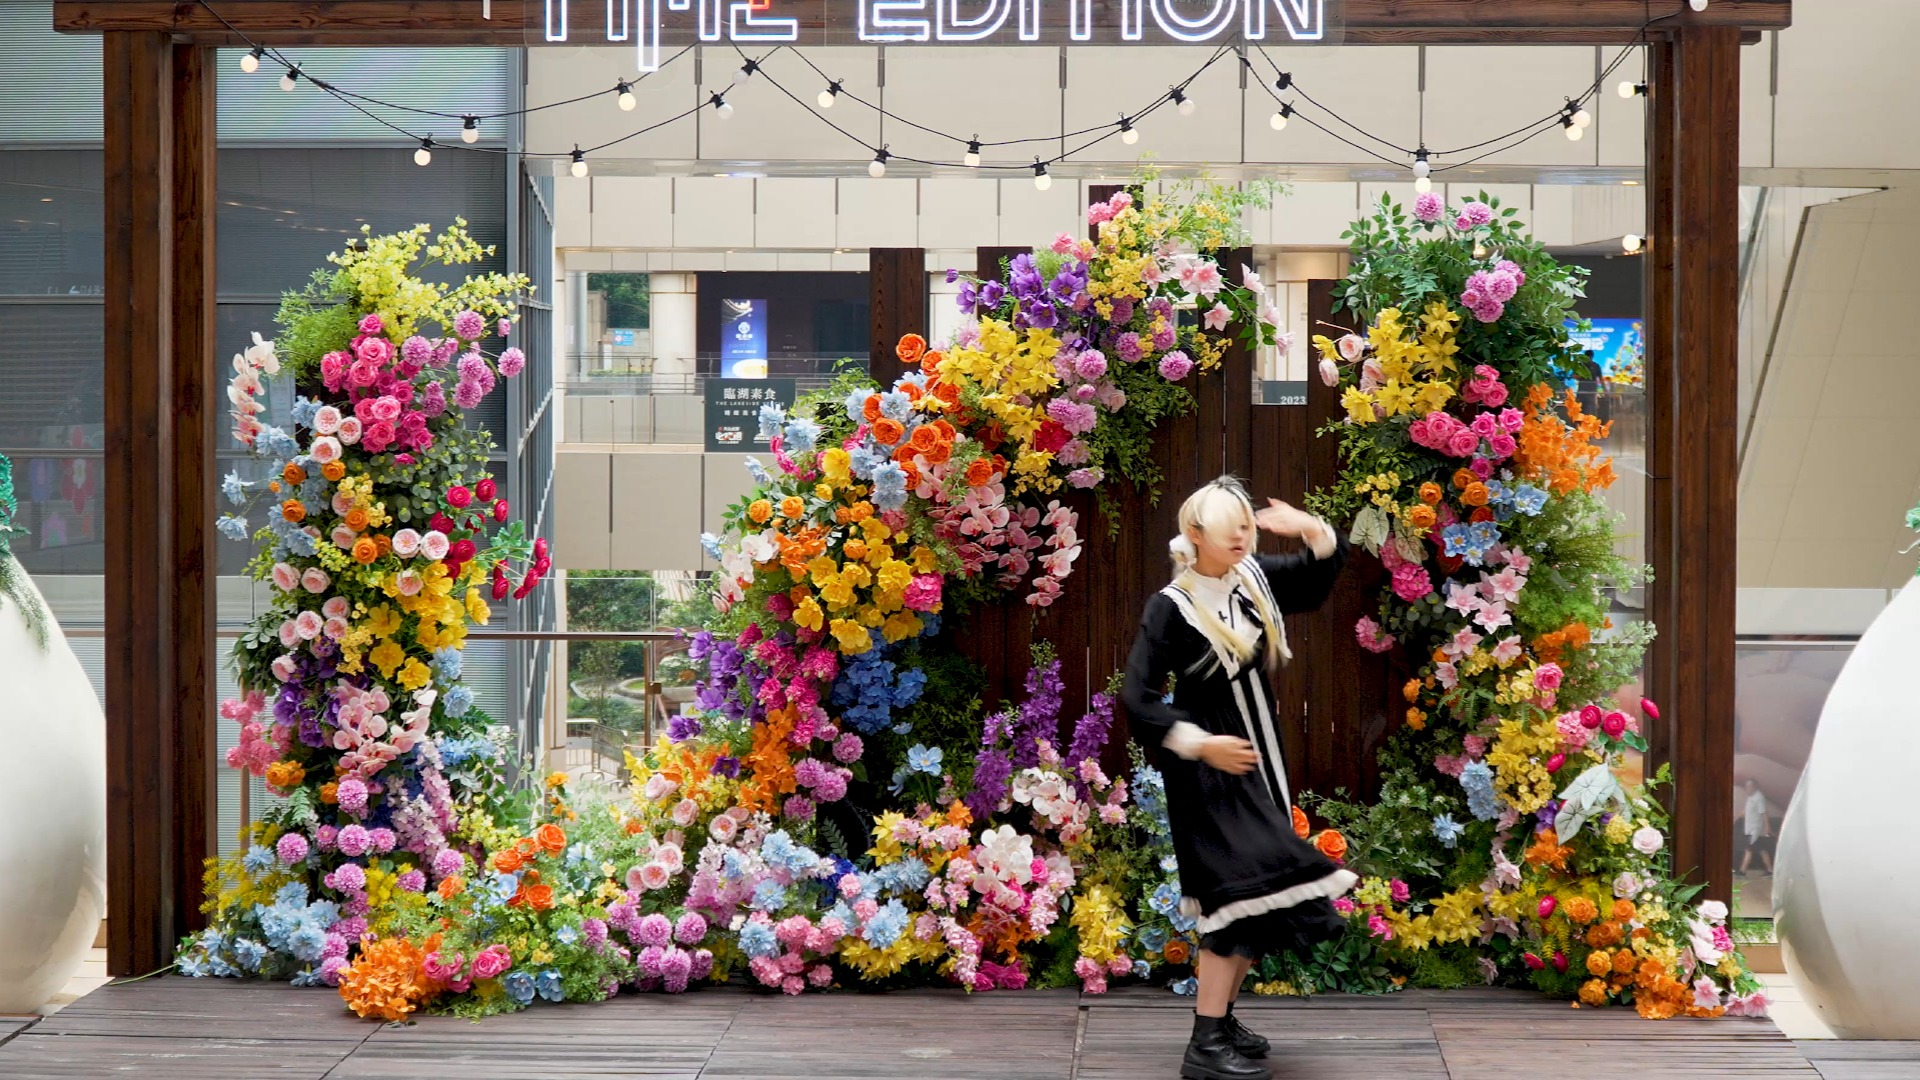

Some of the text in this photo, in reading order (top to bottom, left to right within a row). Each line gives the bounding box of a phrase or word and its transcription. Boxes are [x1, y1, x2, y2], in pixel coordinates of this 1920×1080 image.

[723, 388, 776, 400] 臨湖素食
[1280, 395, 1306, 405] 2023
